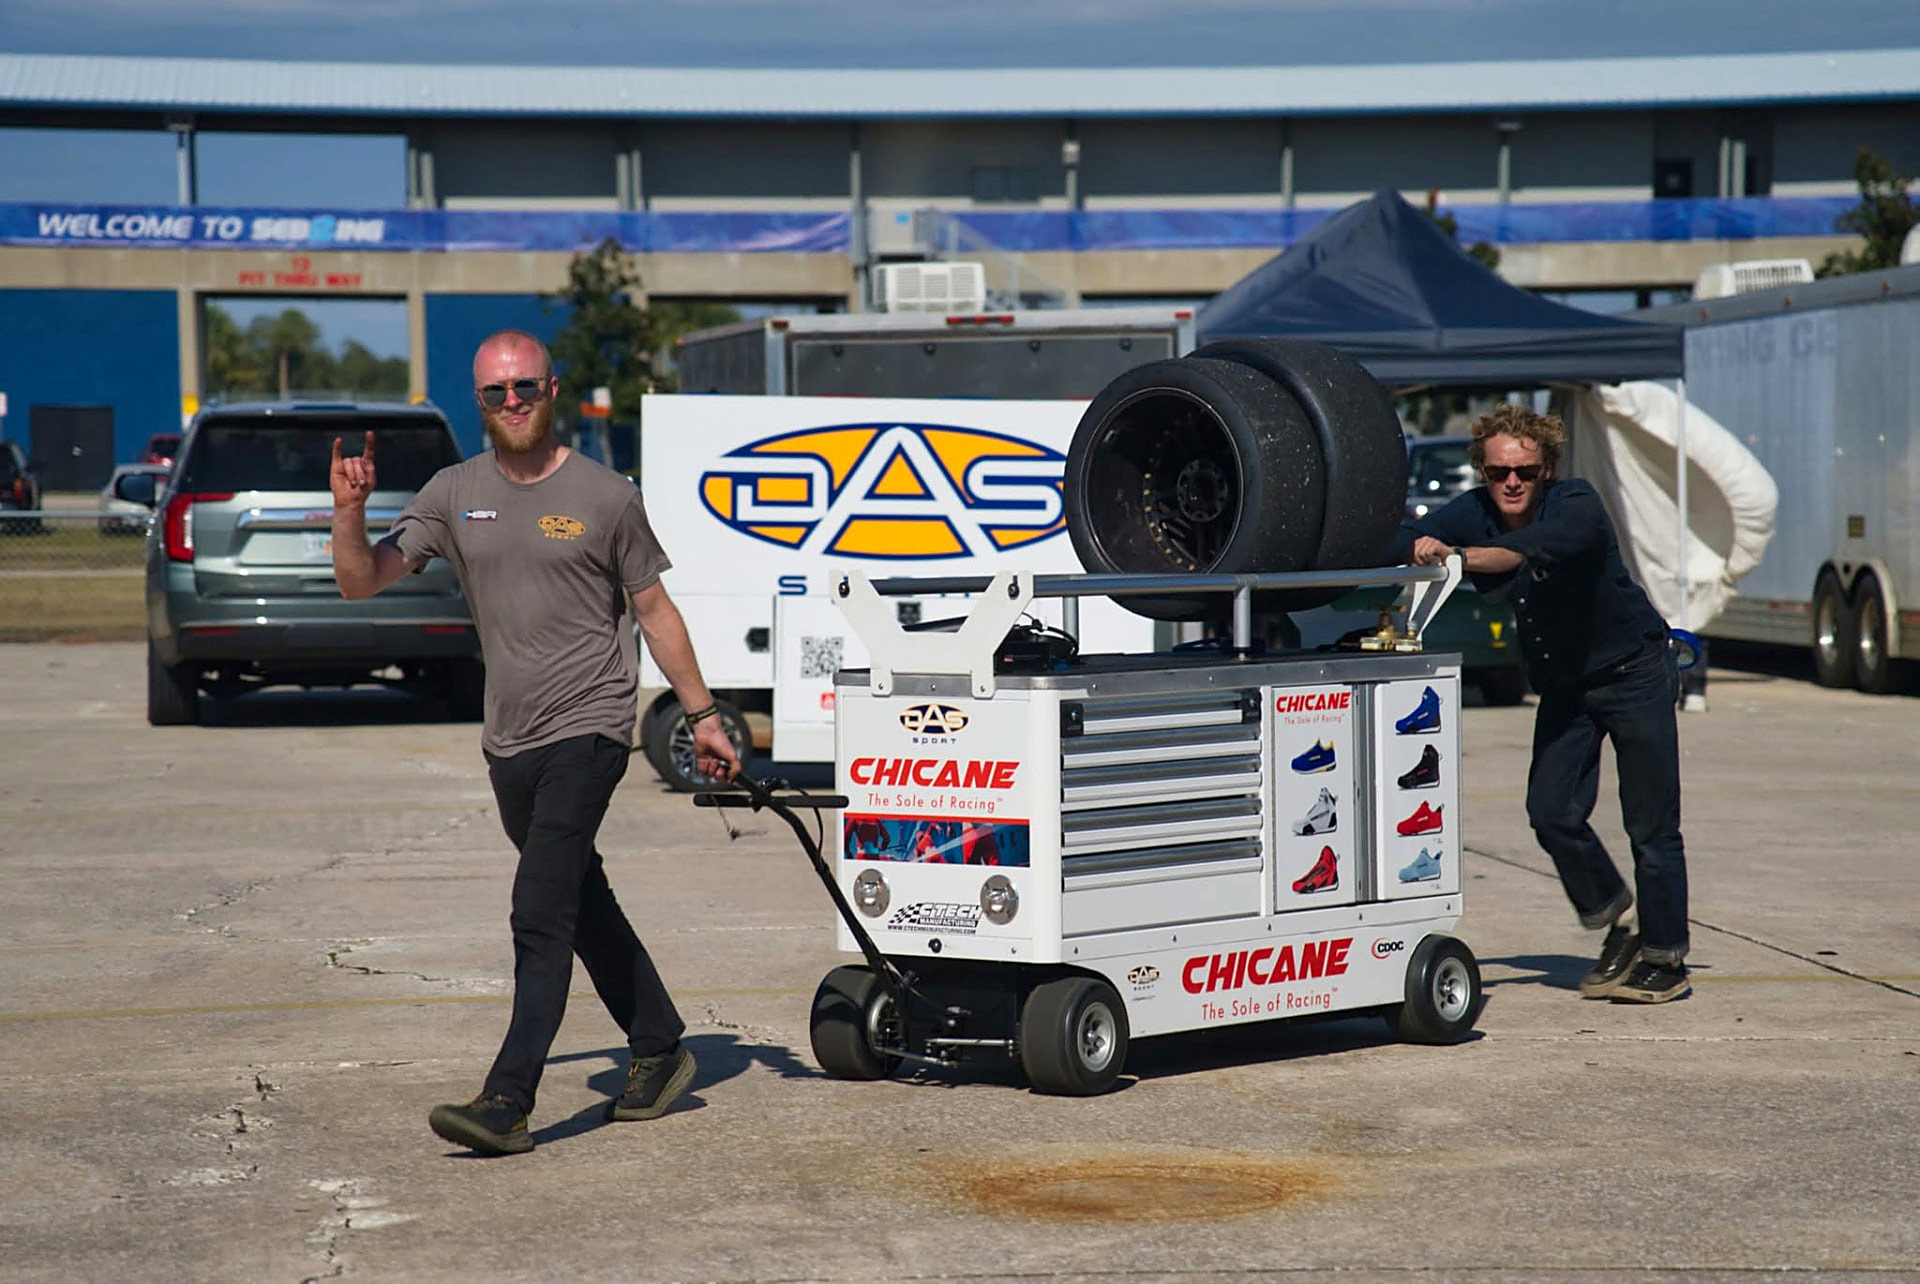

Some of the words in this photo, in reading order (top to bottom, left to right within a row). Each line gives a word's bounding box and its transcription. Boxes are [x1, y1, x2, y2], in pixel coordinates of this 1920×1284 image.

[38, 213, 194, 239] WELCOME
[202, 215, 242, 240] TO
[700, 424, 1066, 556] DAS
[1276, 691, 1352, 713] CHICANE
[899, 703, 970, 735] DAS
[849, 757, 1021, 790] CHICANE
[868, 793, 890, 807] The
[896, 794, 924, 809] Sole
[930, 795, 945, 808] of
[1378, 940, 1404, 953] CDOC
[1182, 937, 1354, 995] CHICANE
[1202, 1003, 1225, 1021] The
[1232, 999, 1260, 1017] Sole
[1267, 995, 1280, 1011] of
